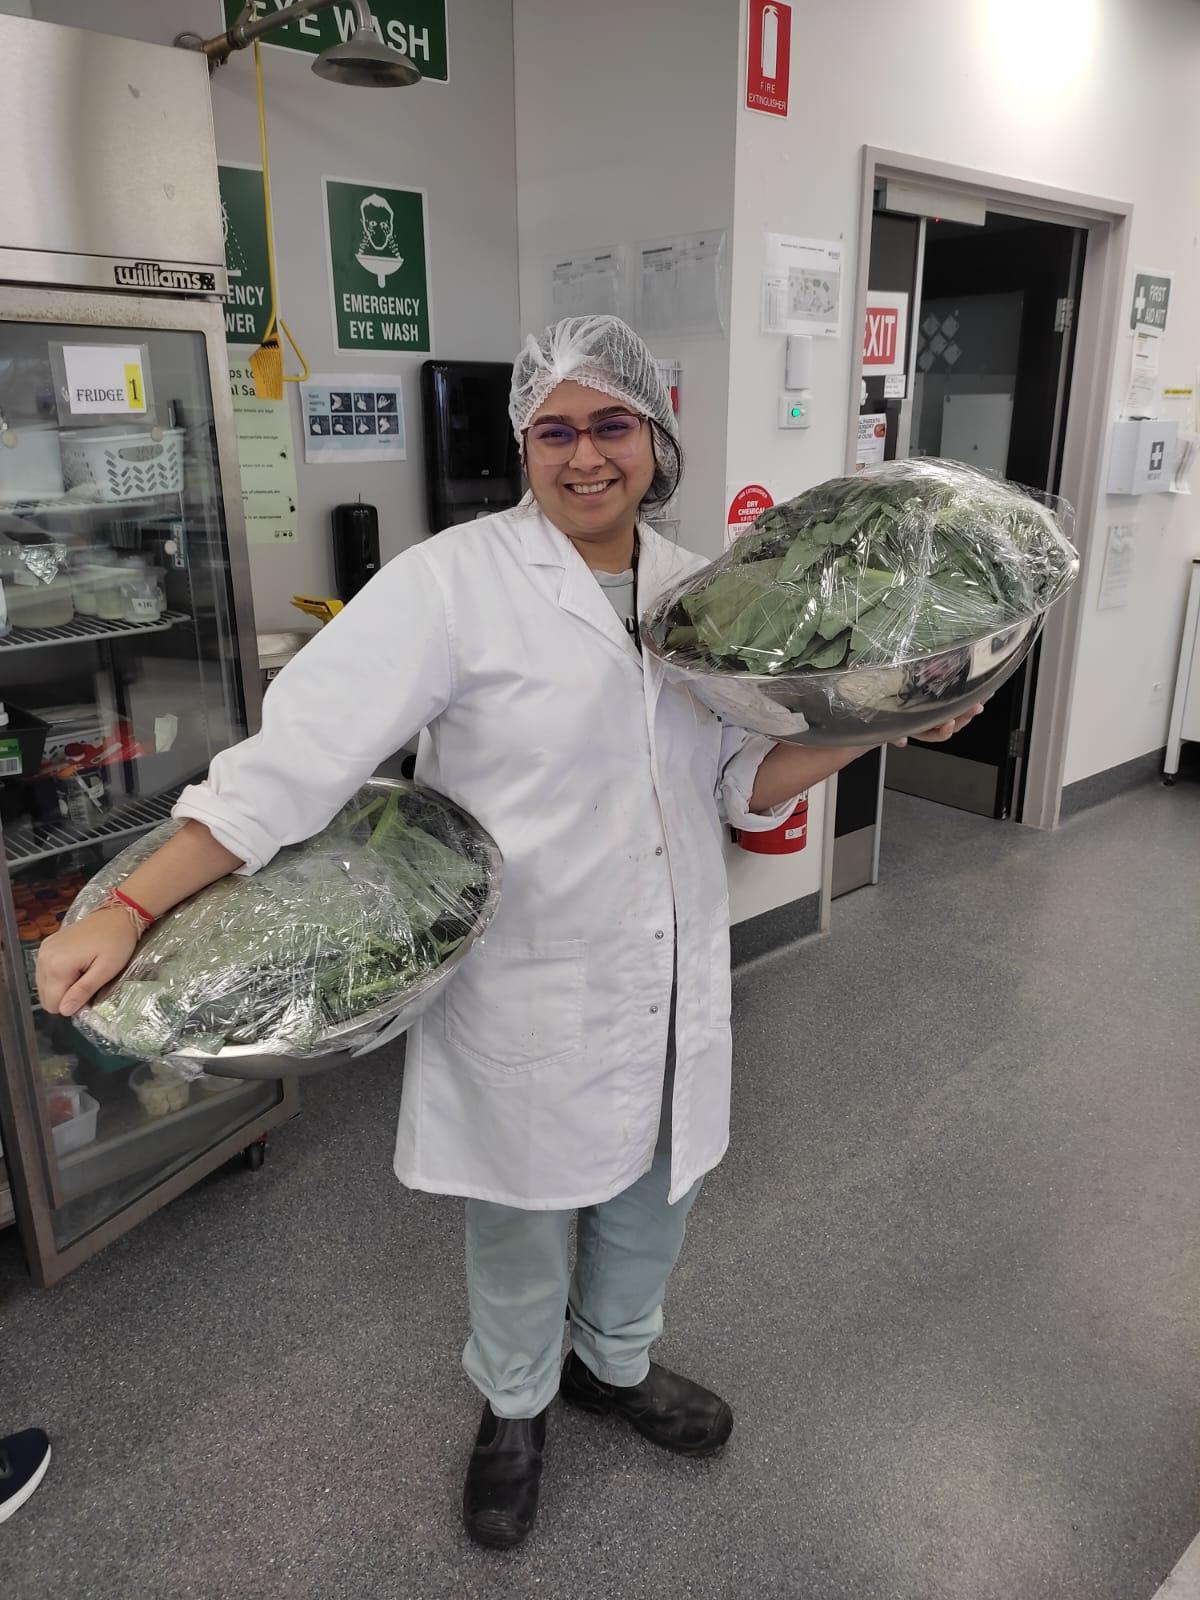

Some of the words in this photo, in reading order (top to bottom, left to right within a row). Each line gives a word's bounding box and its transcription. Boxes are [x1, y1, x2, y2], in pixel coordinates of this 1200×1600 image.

[760, 81, 776, 94] FIRE
[748, 93, 787, 111] EXTINGUISHER
[116, 263, 202, 289] williams
[222, 285, 265, 306] ENCY
[1149, 285, 1167, 303] FIRST
[343, 293, 421, 317] EMERGENCY
[1154, 309, 1166, 327] KIT
[350, 321, 374, 340] EYE
[381, 323, 419, 342] WASH
[864, 314, 896, 357] XIT
[76, 388, 125, 402] FRIDGE
[129, 379, 140, 401] 1
